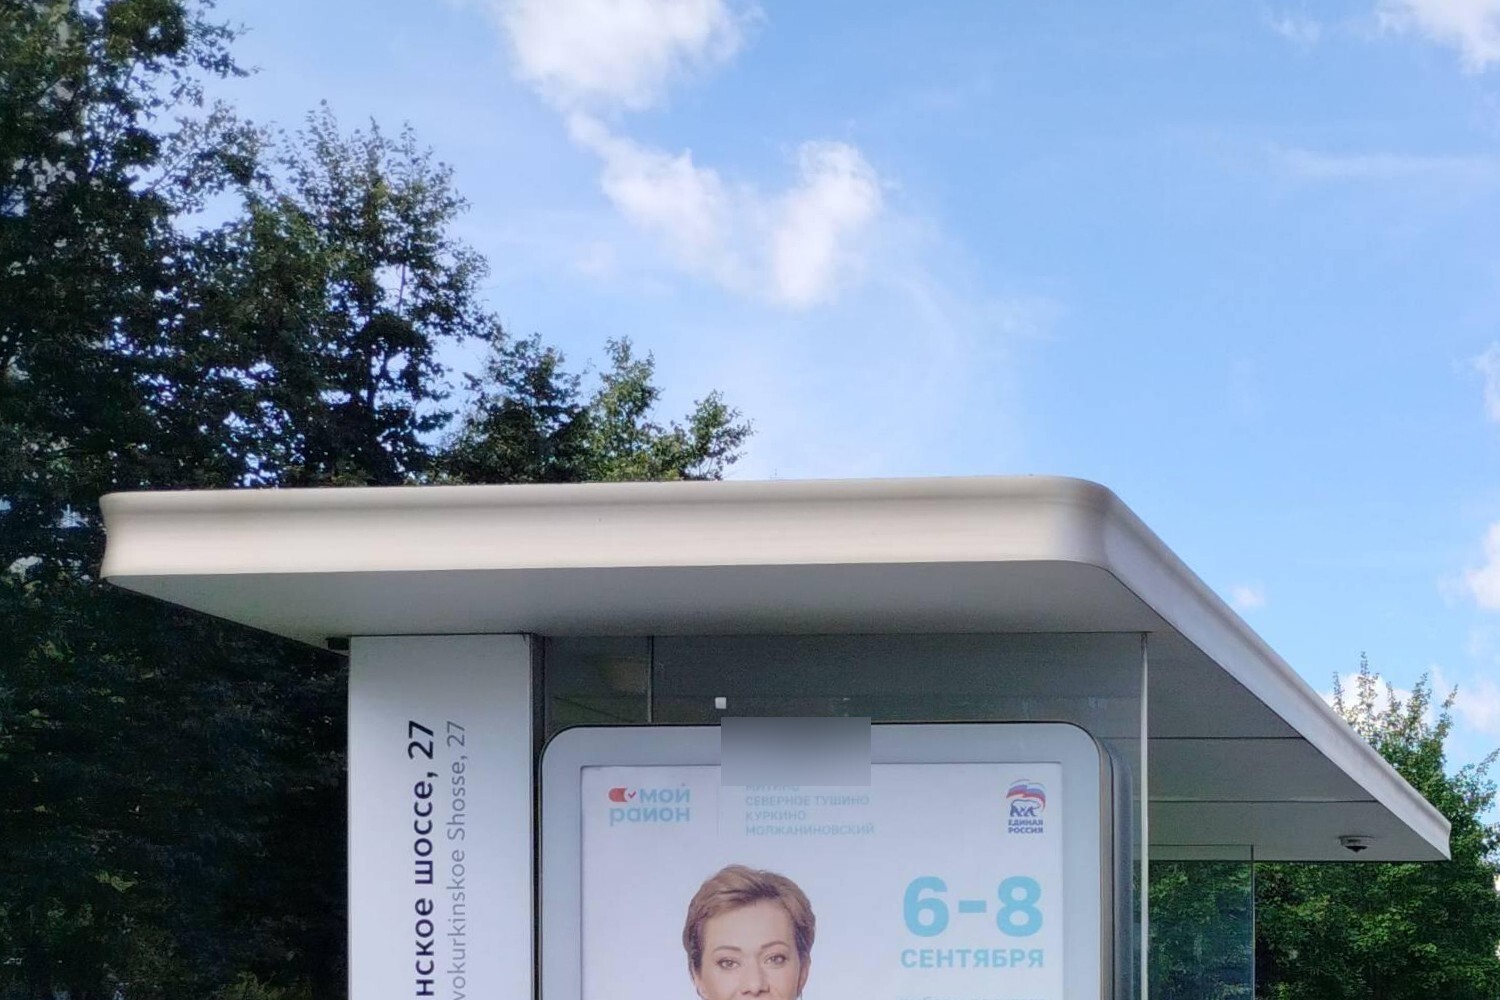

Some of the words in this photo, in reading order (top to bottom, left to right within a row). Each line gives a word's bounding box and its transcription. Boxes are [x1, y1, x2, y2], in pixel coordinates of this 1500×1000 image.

[408, 720, 434, 760] 27
[447, 721, 466, 747] 27
[447, 755, 467, 840] Shosse,
[745, 796, 810, 807] СЕВЕРНОЕ
[815, 796, 870, 806] ТУШИНО
[745, 810, 807, 821] КУРКИНО
[414, 771, 438, 885] шоссе,
[745, 822, 876, 837] МОЛЖАНИНОВСКИЙ
[900, 948, 1045, 969] СЕНТЯБРЯ
